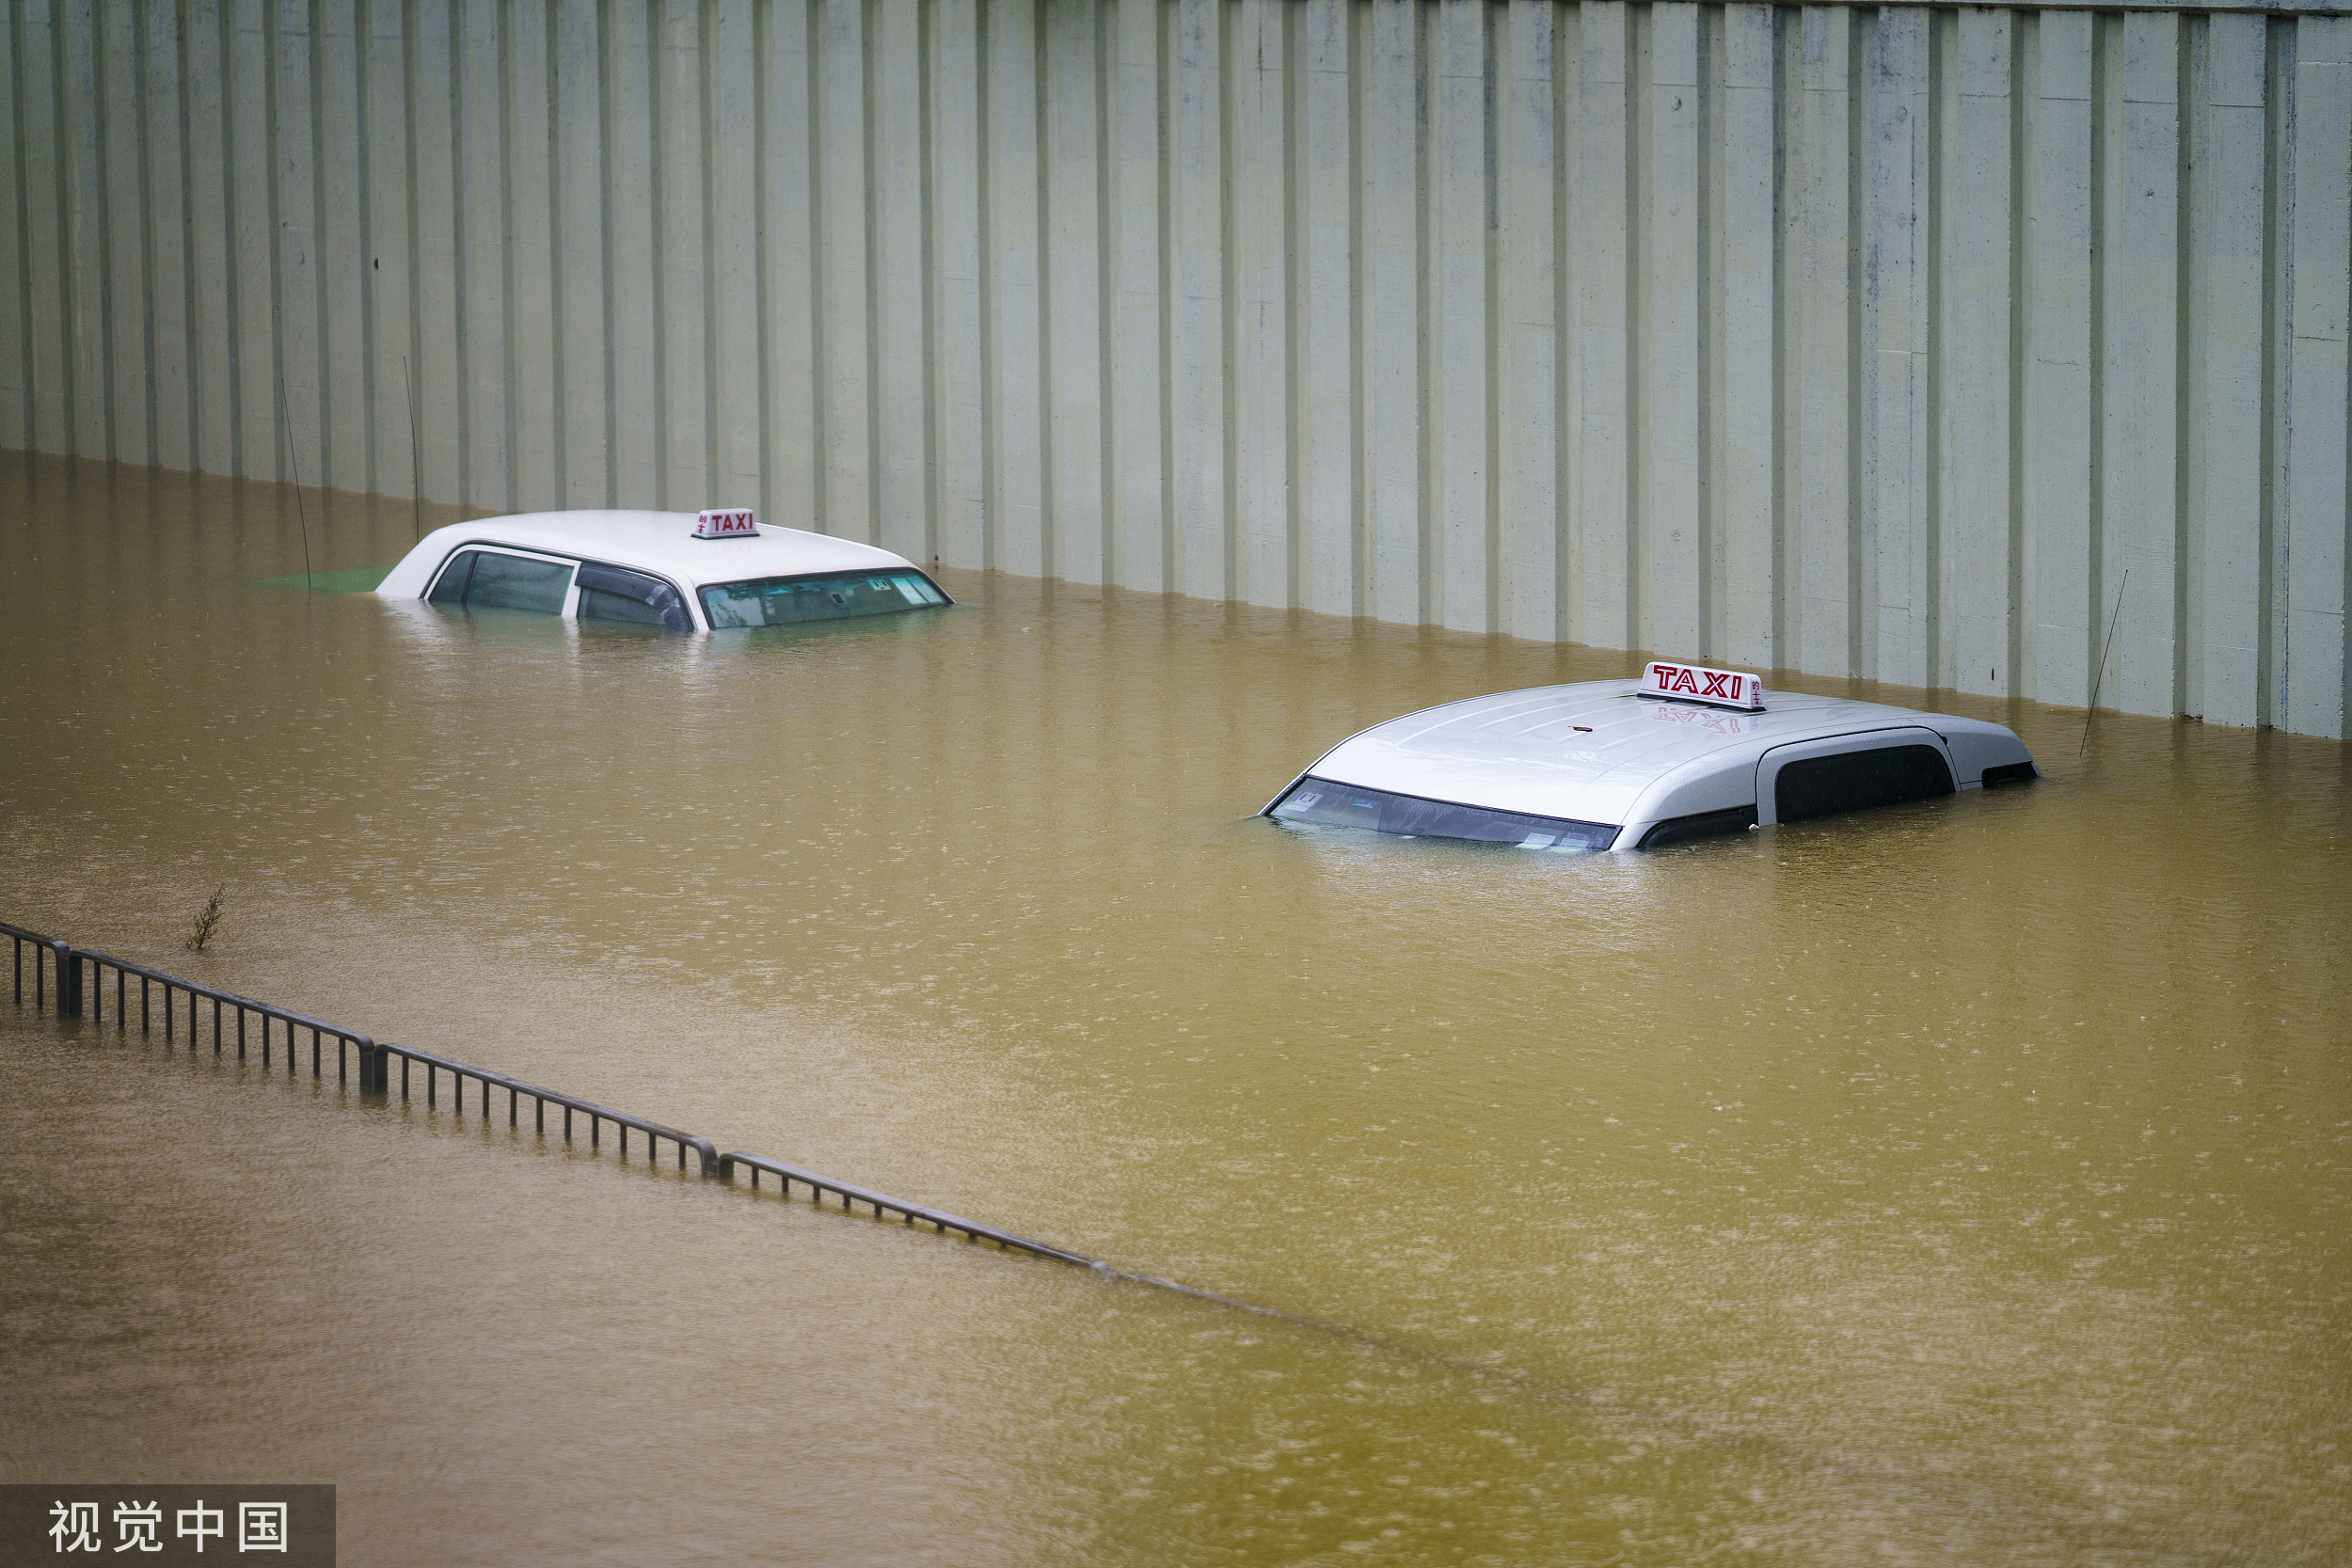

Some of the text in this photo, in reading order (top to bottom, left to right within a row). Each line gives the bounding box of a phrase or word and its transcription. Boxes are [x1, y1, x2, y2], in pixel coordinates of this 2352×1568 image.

[712, 513, 753, 531] TAXI
[1653, 665, 1742, 700] TAXI
[1752, 680, 1760, 701] 的士
